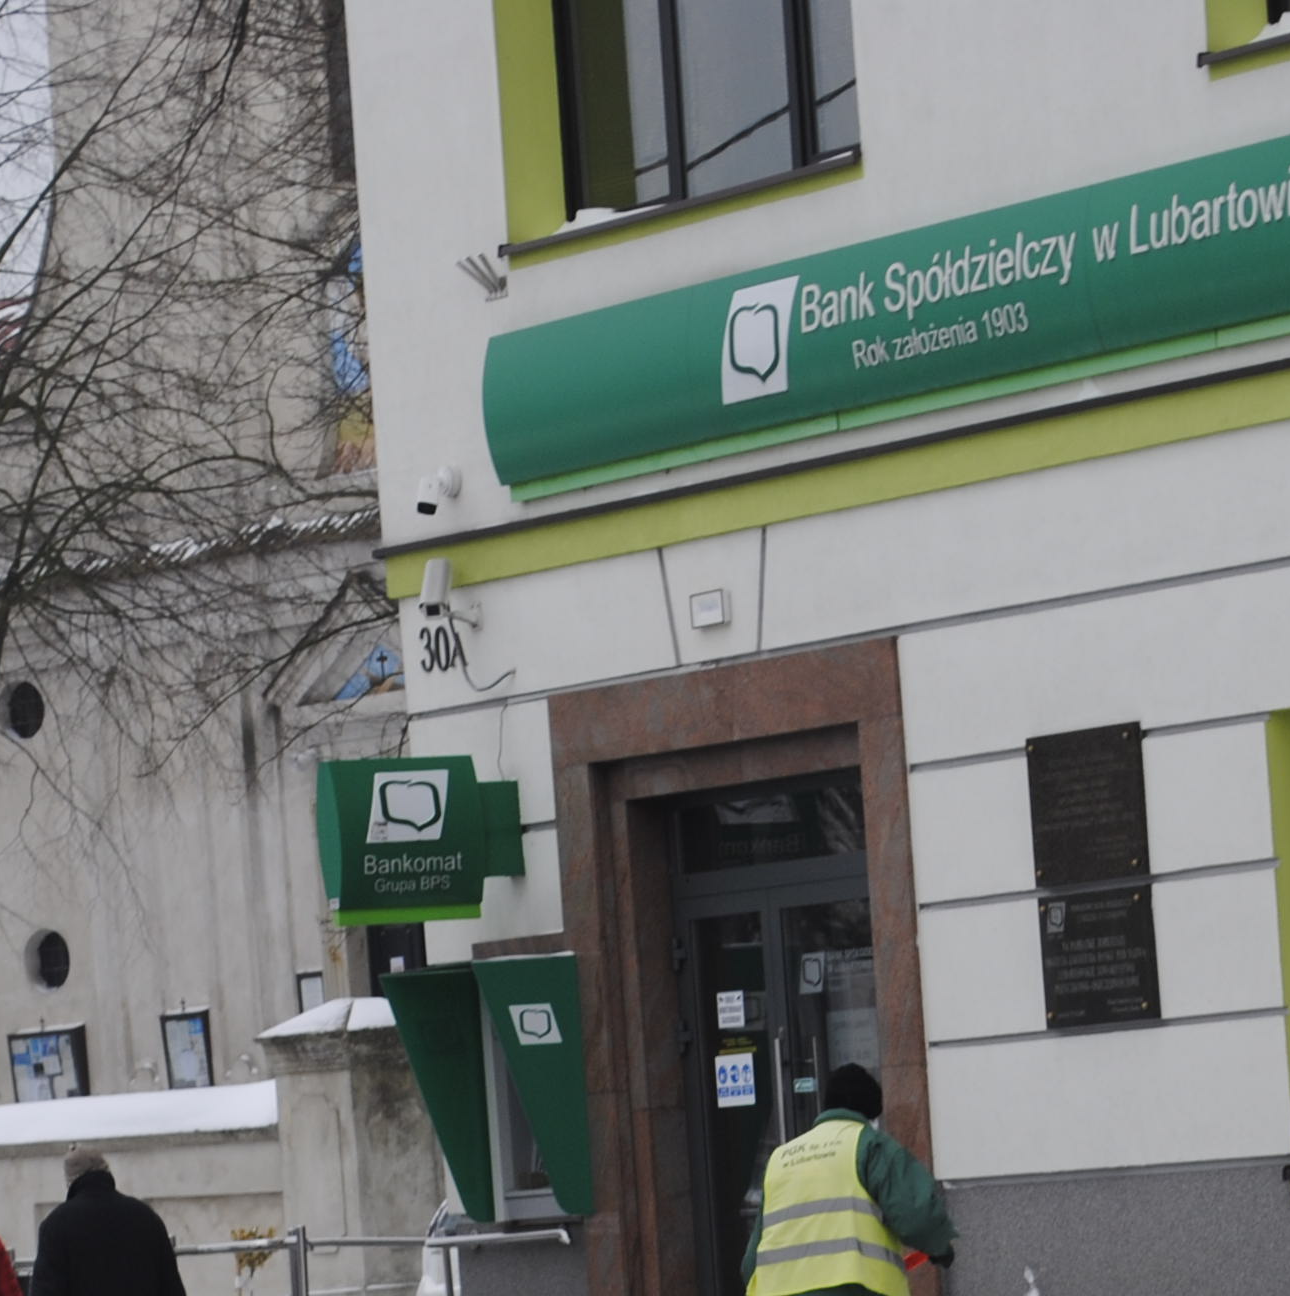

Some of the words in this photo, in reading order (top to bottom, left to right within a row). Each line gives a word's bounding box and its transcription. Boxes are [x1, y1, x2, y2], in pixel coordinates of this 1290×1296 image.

[800, 272, 876, 334] Bank
[883, 231, 1077, 320] Spółdzielczy
[1092, 221, 1120, 263] w
[852, 335, 890, 369] Rok
[891, 317, 978, 361] założenia
[980, 301, 1029, 339] 1903
[419, 625, 469, 673] 30A
[364, 851, 463, 875] Bankomat
[374, 878, 416, 894] Grupa
[420, 874, 451, 890] BPS
